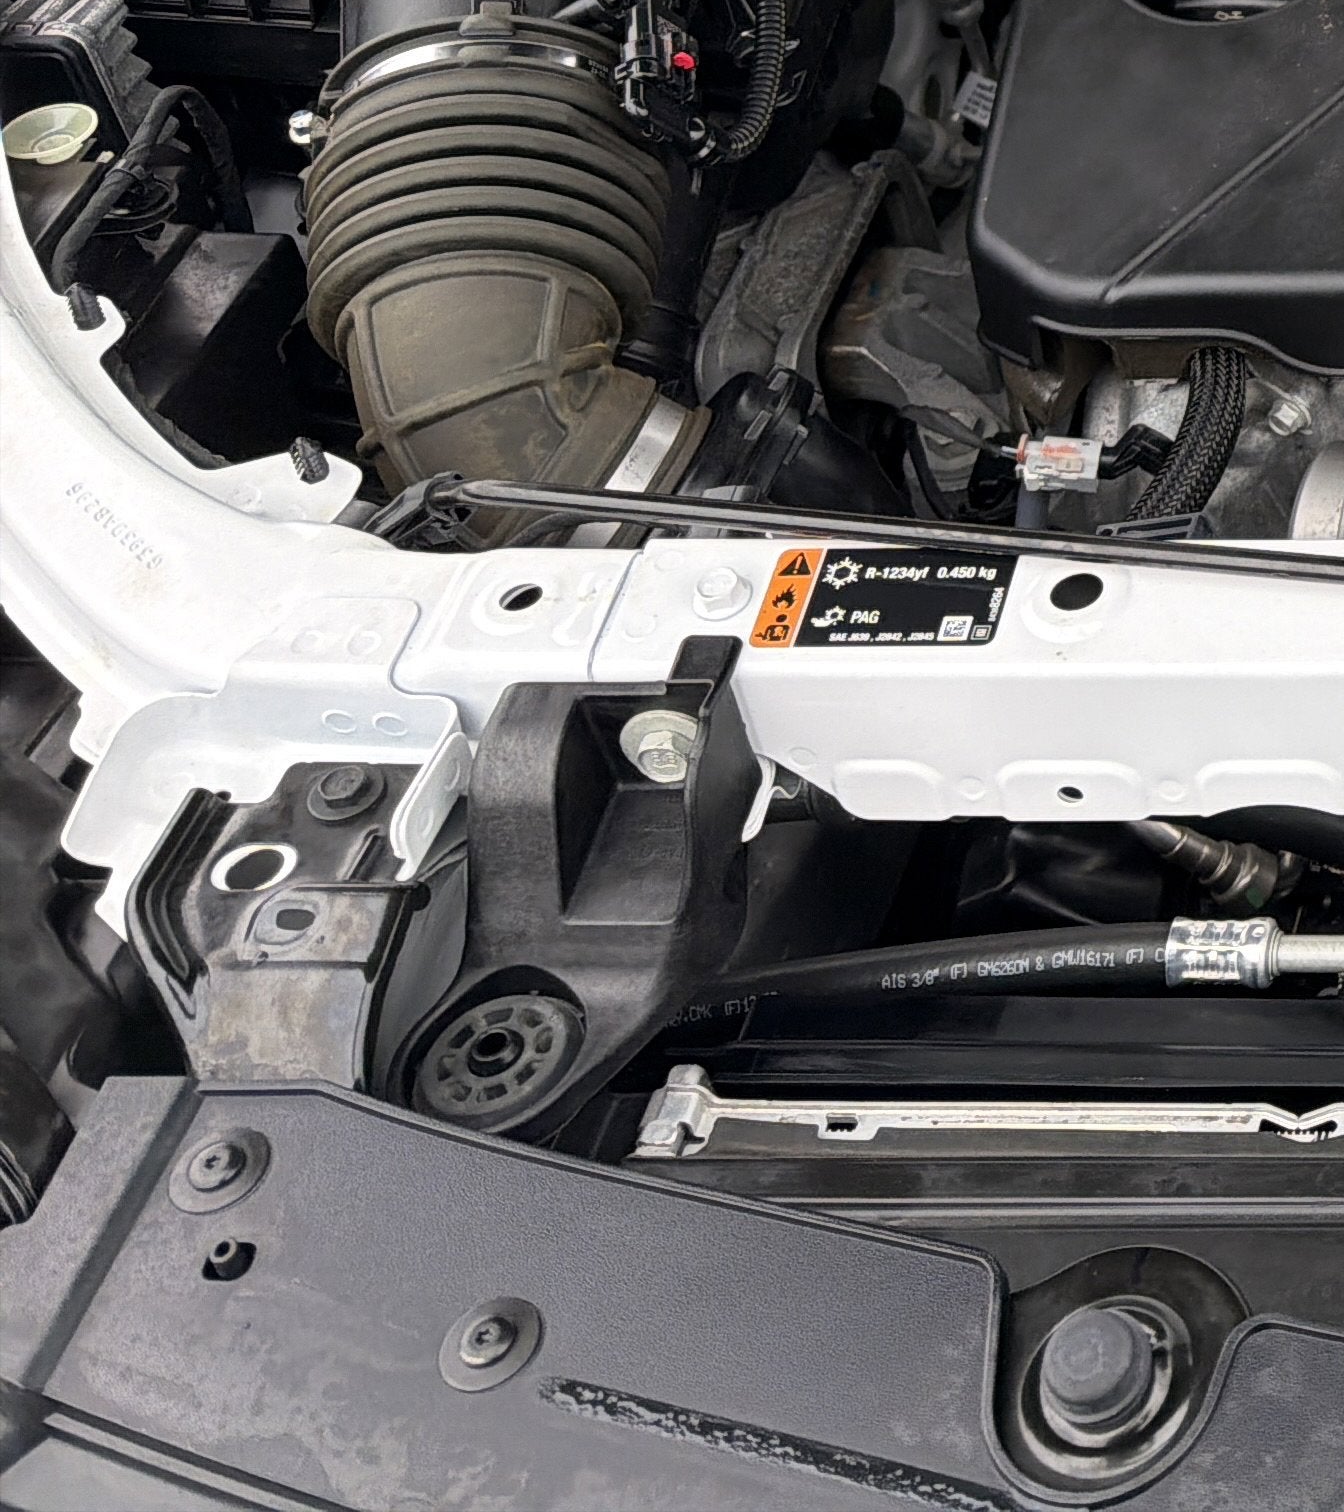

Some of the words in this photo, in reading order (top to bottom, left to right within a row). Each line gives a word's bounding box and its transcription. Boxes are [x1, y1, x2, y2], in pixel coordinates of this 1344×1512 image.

[865, 567, 929, 582] R-1234yf
[937, 567, 976, 579] 0.450
[978, 567, 997, 581] kg
[850, 610, 880, 624] PAG
[881, 974, 906, 990] AIS
[1035, 956, 1045, 970] &
